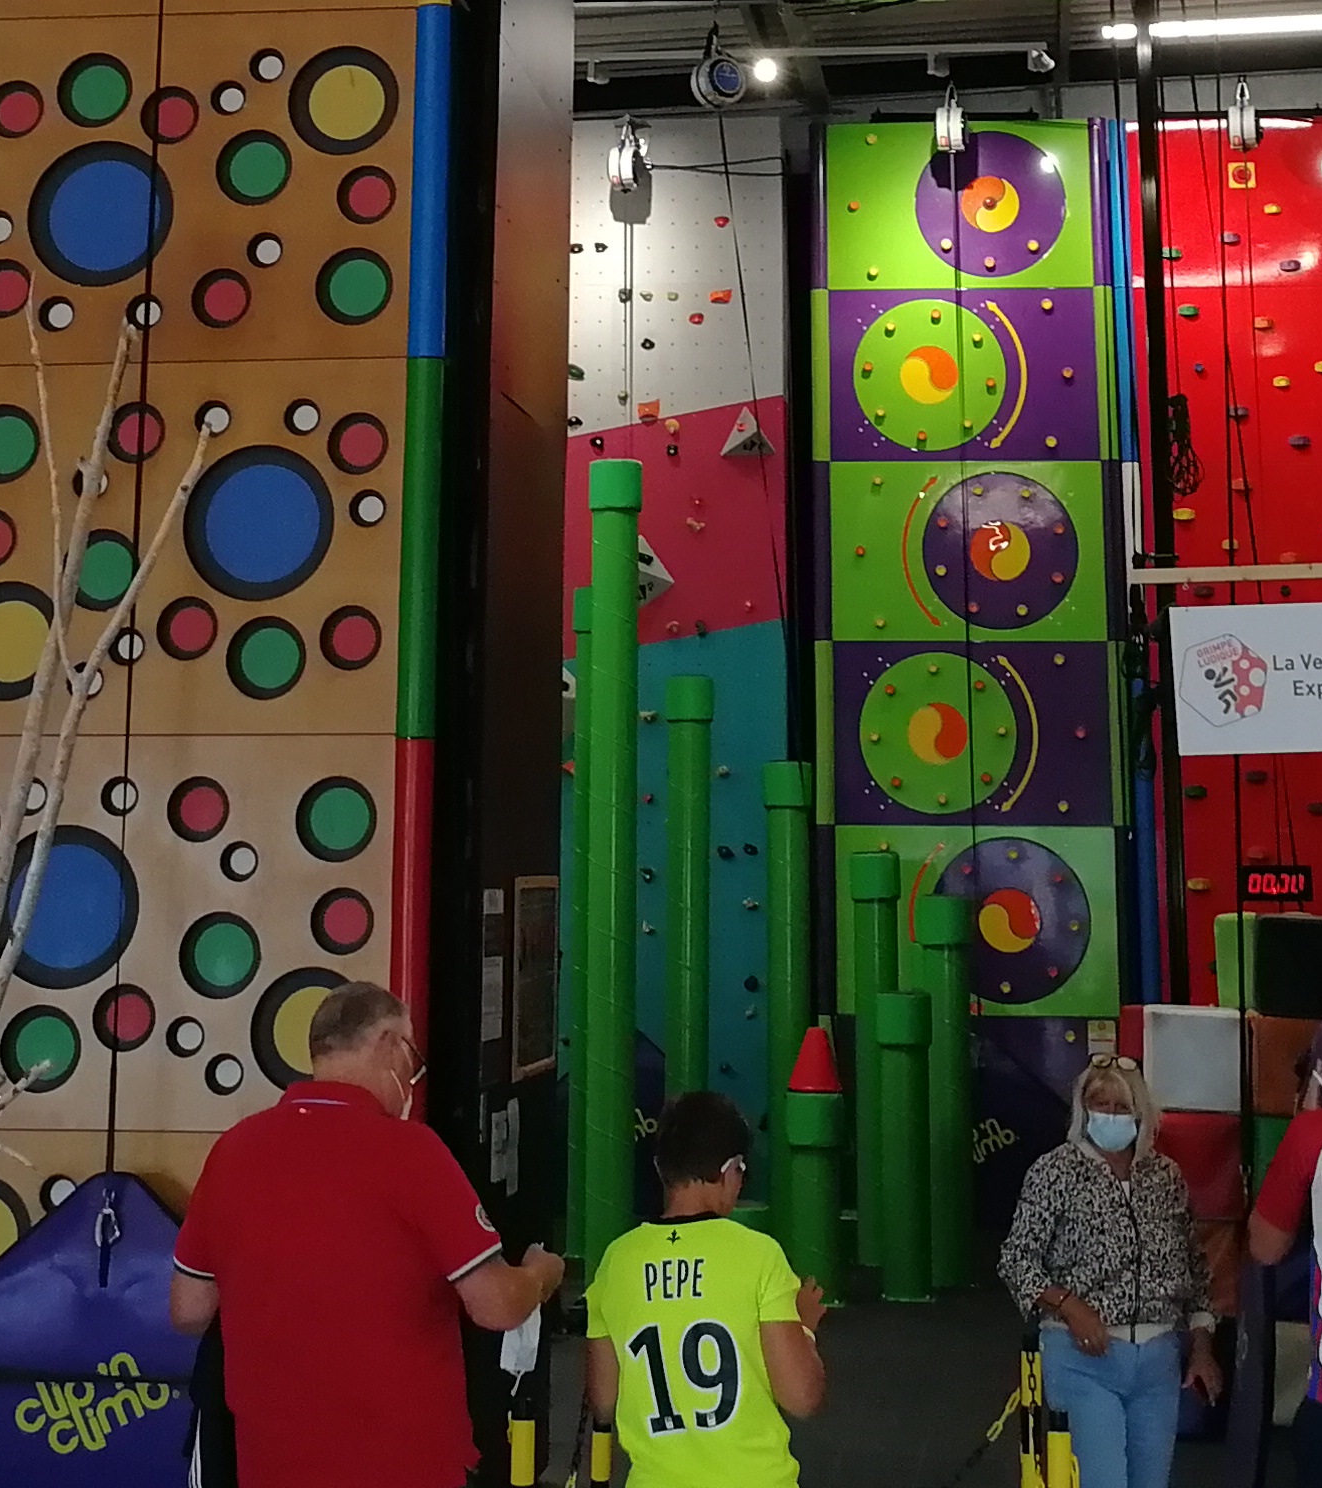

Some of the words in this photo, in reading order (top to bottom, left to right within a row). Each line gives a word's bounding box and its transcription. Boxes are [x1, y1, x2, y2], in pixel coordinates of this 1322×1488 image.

[1196, 638, 1234, 659] GRIMPE
[1197, 648, 1240, 669] LUDIQUE
[1272, 654, 1295, 671] La
[643, 1257, 707, 1303] PEPE
[624, 1318, 742, 1439] 19
